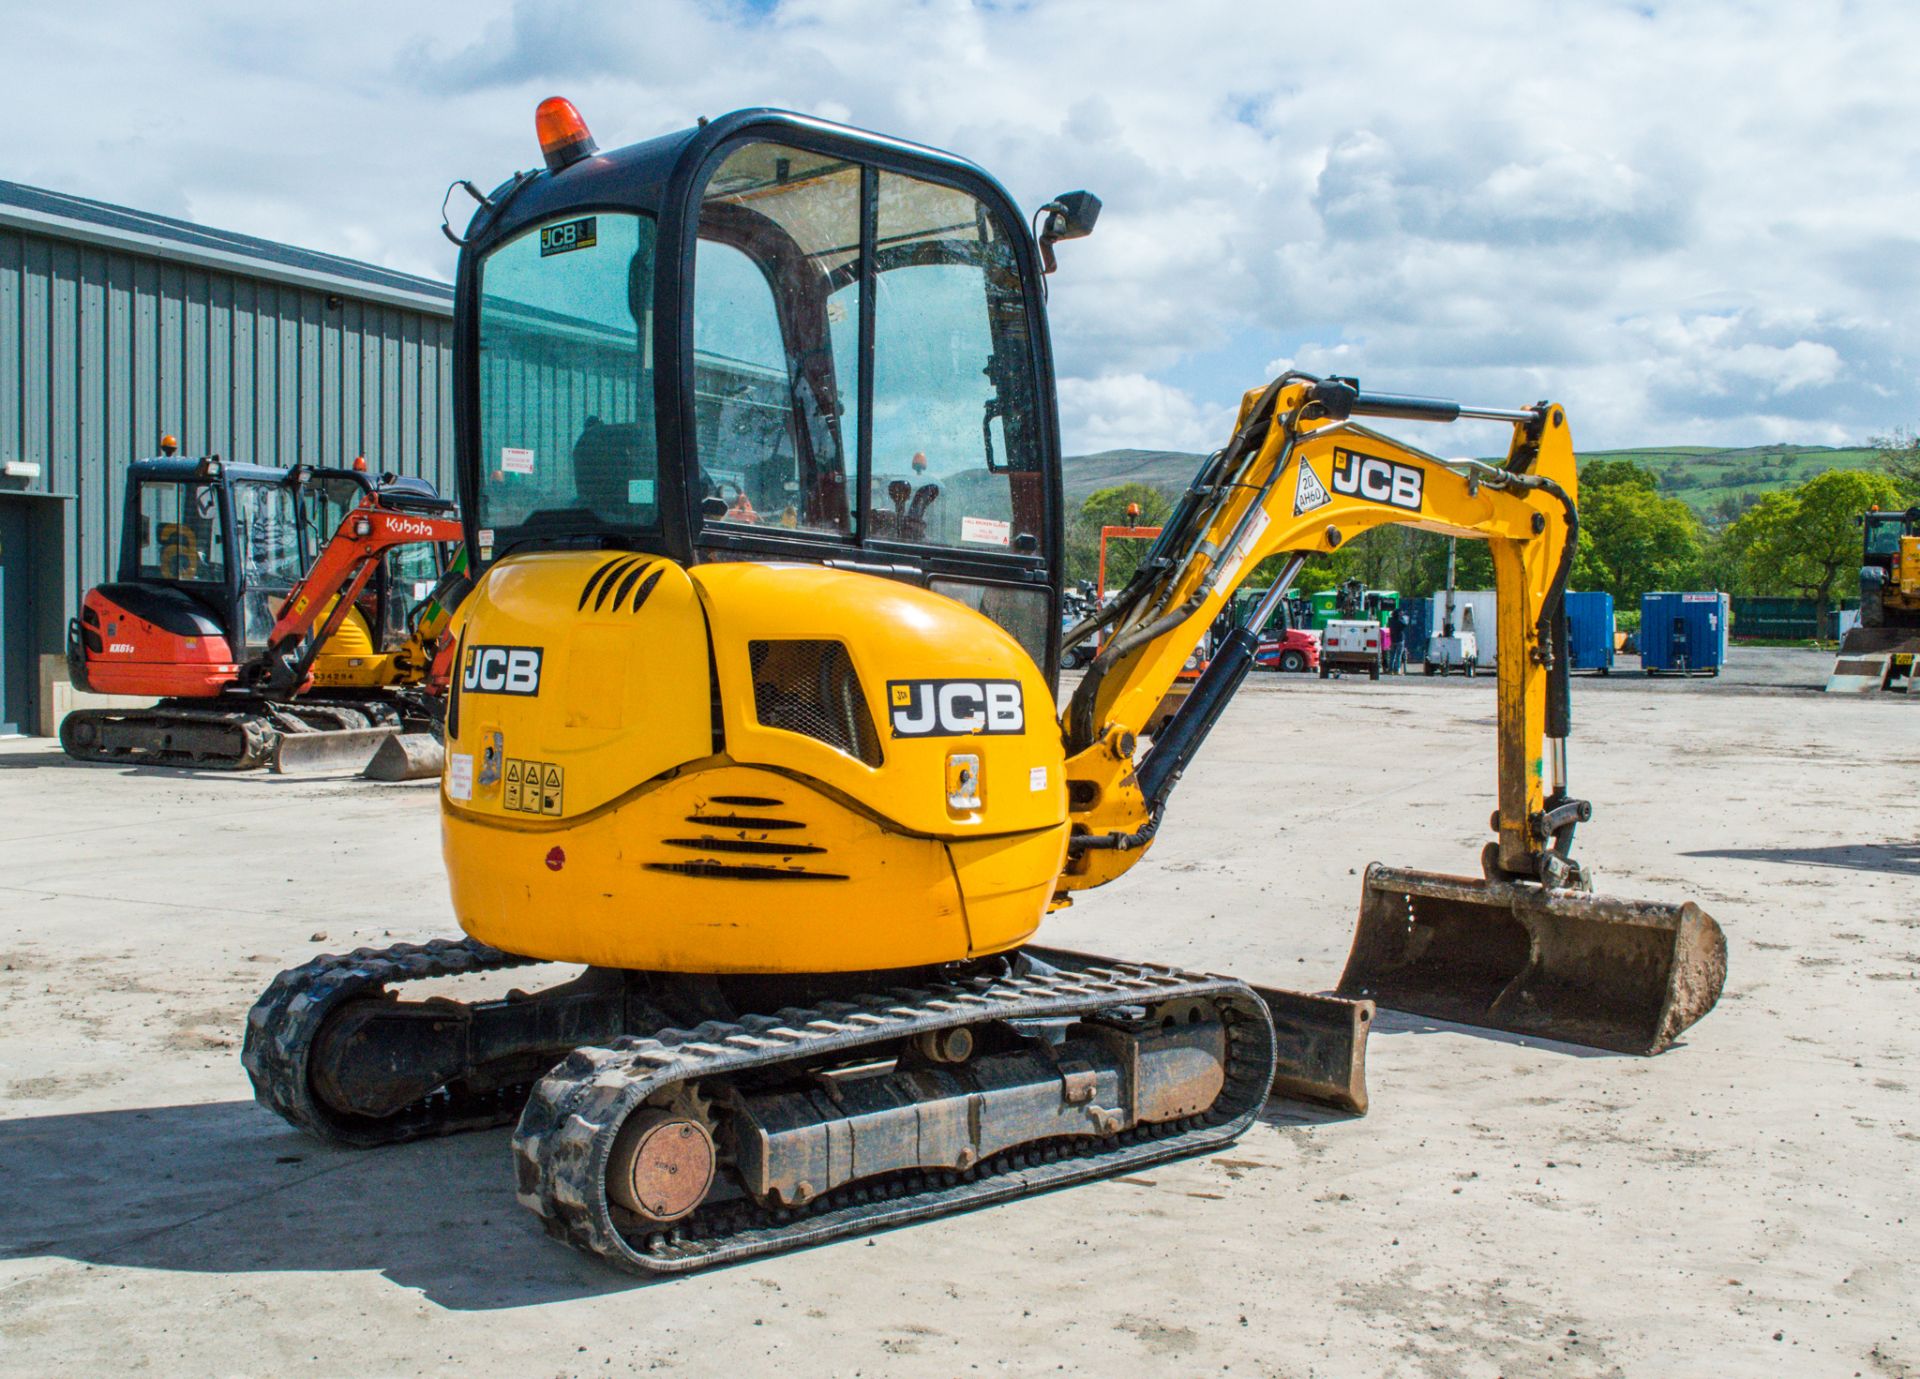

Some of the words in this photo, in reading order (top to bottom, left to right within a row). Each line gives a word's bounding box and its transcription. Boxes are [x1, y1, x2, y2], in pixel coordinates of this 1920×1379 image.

[542, 224, 576, 249] JCB
[1302, 475, 1314, 490] 20
[1334, 454, 1422, 508] JCB
[386, 517, 433, 536] Kubota
[464, 649, 539, 692] JCB
[893, 683, 1023, 733] JCB
